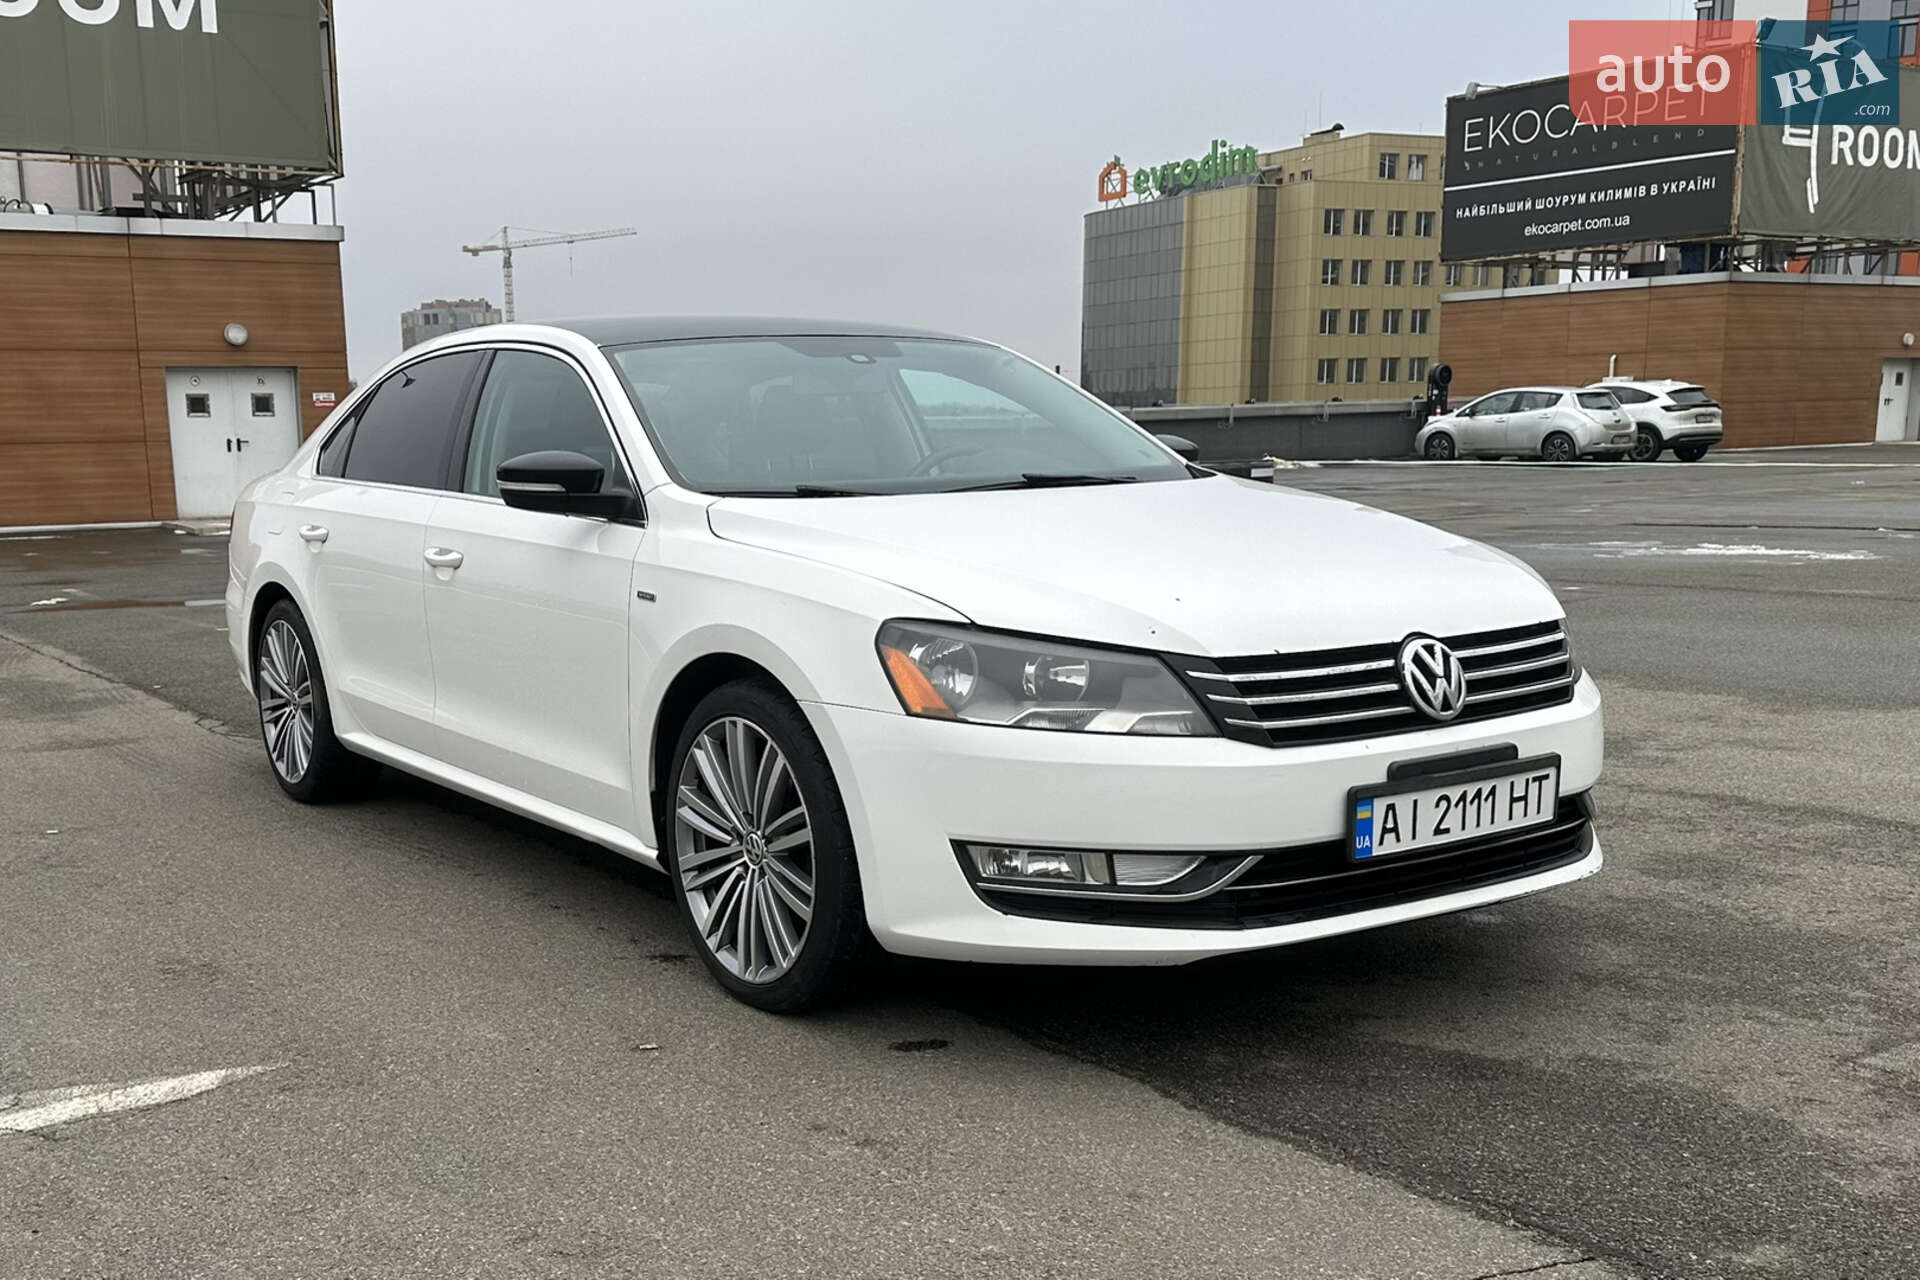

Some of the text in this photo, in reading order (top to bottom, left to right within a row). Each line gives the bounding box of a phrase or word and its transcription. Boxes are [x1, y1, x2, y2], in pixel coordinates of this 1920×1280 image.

[1464, 78, 1717, 152] EKOCARPET
[1133, 139, 1258, 195] evrodim
[1456, 175, 1716, 219] НАЙБІЛЬШИЙ ШОУРУМ КИЛИМІВ В УКРАЇНІ
[1524, 214, 1631, 236] ekocarpet.com.ua
[1433, 785, 1496, 836] 2111
[1508, 773, 1550, 821] HT
[1356, 835, 1371, 849] UA
